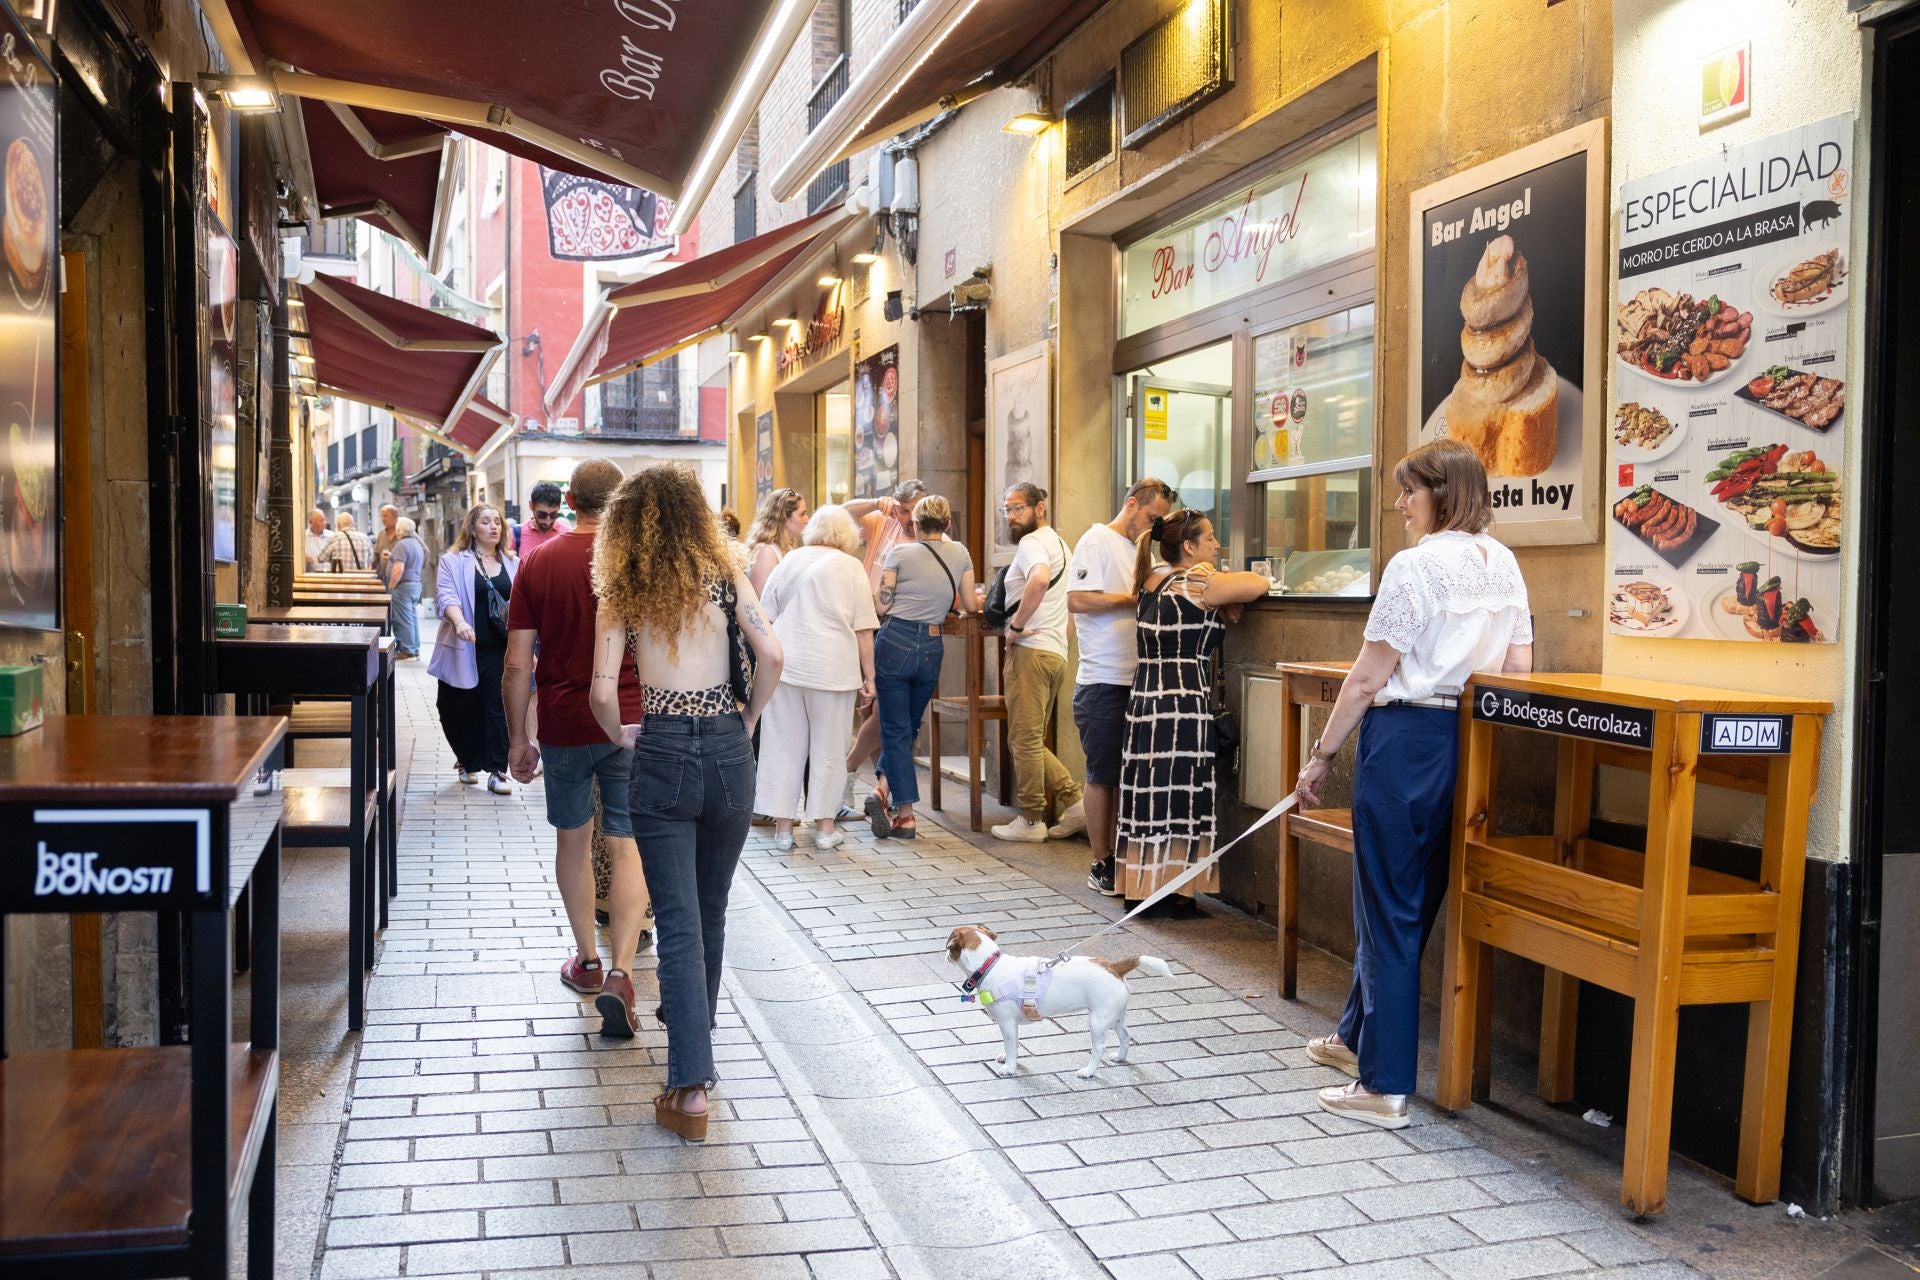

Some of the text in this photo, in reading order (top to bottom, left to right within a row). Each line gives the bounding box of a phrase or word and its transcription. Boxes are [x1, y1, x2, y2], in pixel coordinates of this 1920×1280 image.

[600, 35, 664, 101] Bar
[1625, 141, 1842, 234] ESPECIALIDAD
[1152, 172, 1308, 300] Bar Angel
[1431, 187, 1532, 247] Bar Angel
[1622, 214, 1795, 270] MORRO DE CERDO A LA BRASA
[1532, 478, 1574, 511] hoy
[1503, 698, 1642, 737] Bodegas Cerrolaza
[34, 866, 173, 895] DONOSTI
[37, 841, 99, 873] bar
